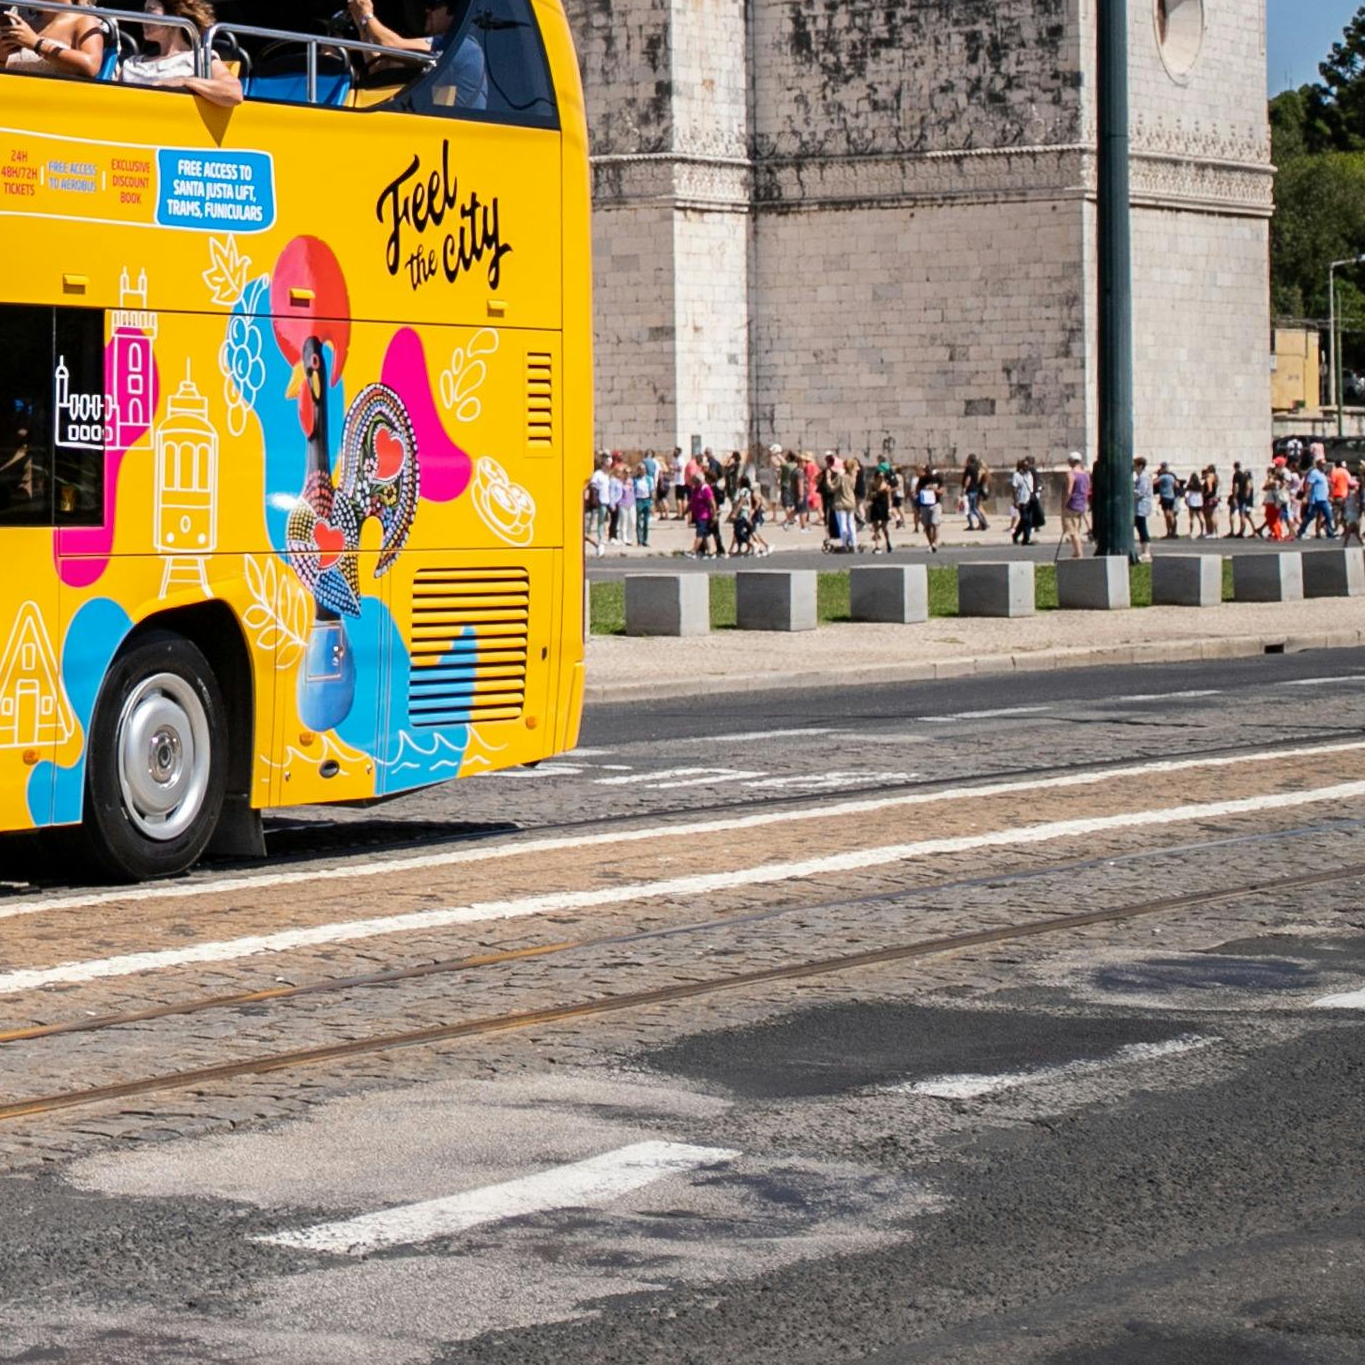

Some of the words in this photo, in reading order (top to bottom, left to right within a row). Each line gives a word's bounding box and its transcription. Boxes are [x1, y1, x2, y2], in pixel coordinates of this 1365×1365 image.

[11, 150, 28, 163] 24H
[1, 166, 37, 180] 48H/72H
[48, 161, 68, 174] FREE
[69, 162, 97, 176] ACCESS
[111, 158, 150, 173] EXCLUSIVE
[178, 159, 202, 177] FREE
[204, 162, 237, 180] ACCESS
[239, 165, 252, 181] TO
[4, 182, 35, 196] TICKETS
[48, 177, 59, 189] TO
[61, 178, 97, 193] AEROBUS
[113, 175, 149, 189] DISCOUNT
[120, 191, 141, 204] BOOK
[173, 179, 205, 198] SANTA
[206, 181, 234, 201] JUSTA
[235, 185, 257, 203] LIFT,
[167, 199, 203, 218] TRAMS,
[204, 202, 262, 222] FUNICULARS
[376, 139, 457, 275] Feel
[404, 244, 438, 291] the
[443, 192, 513, 290] city
